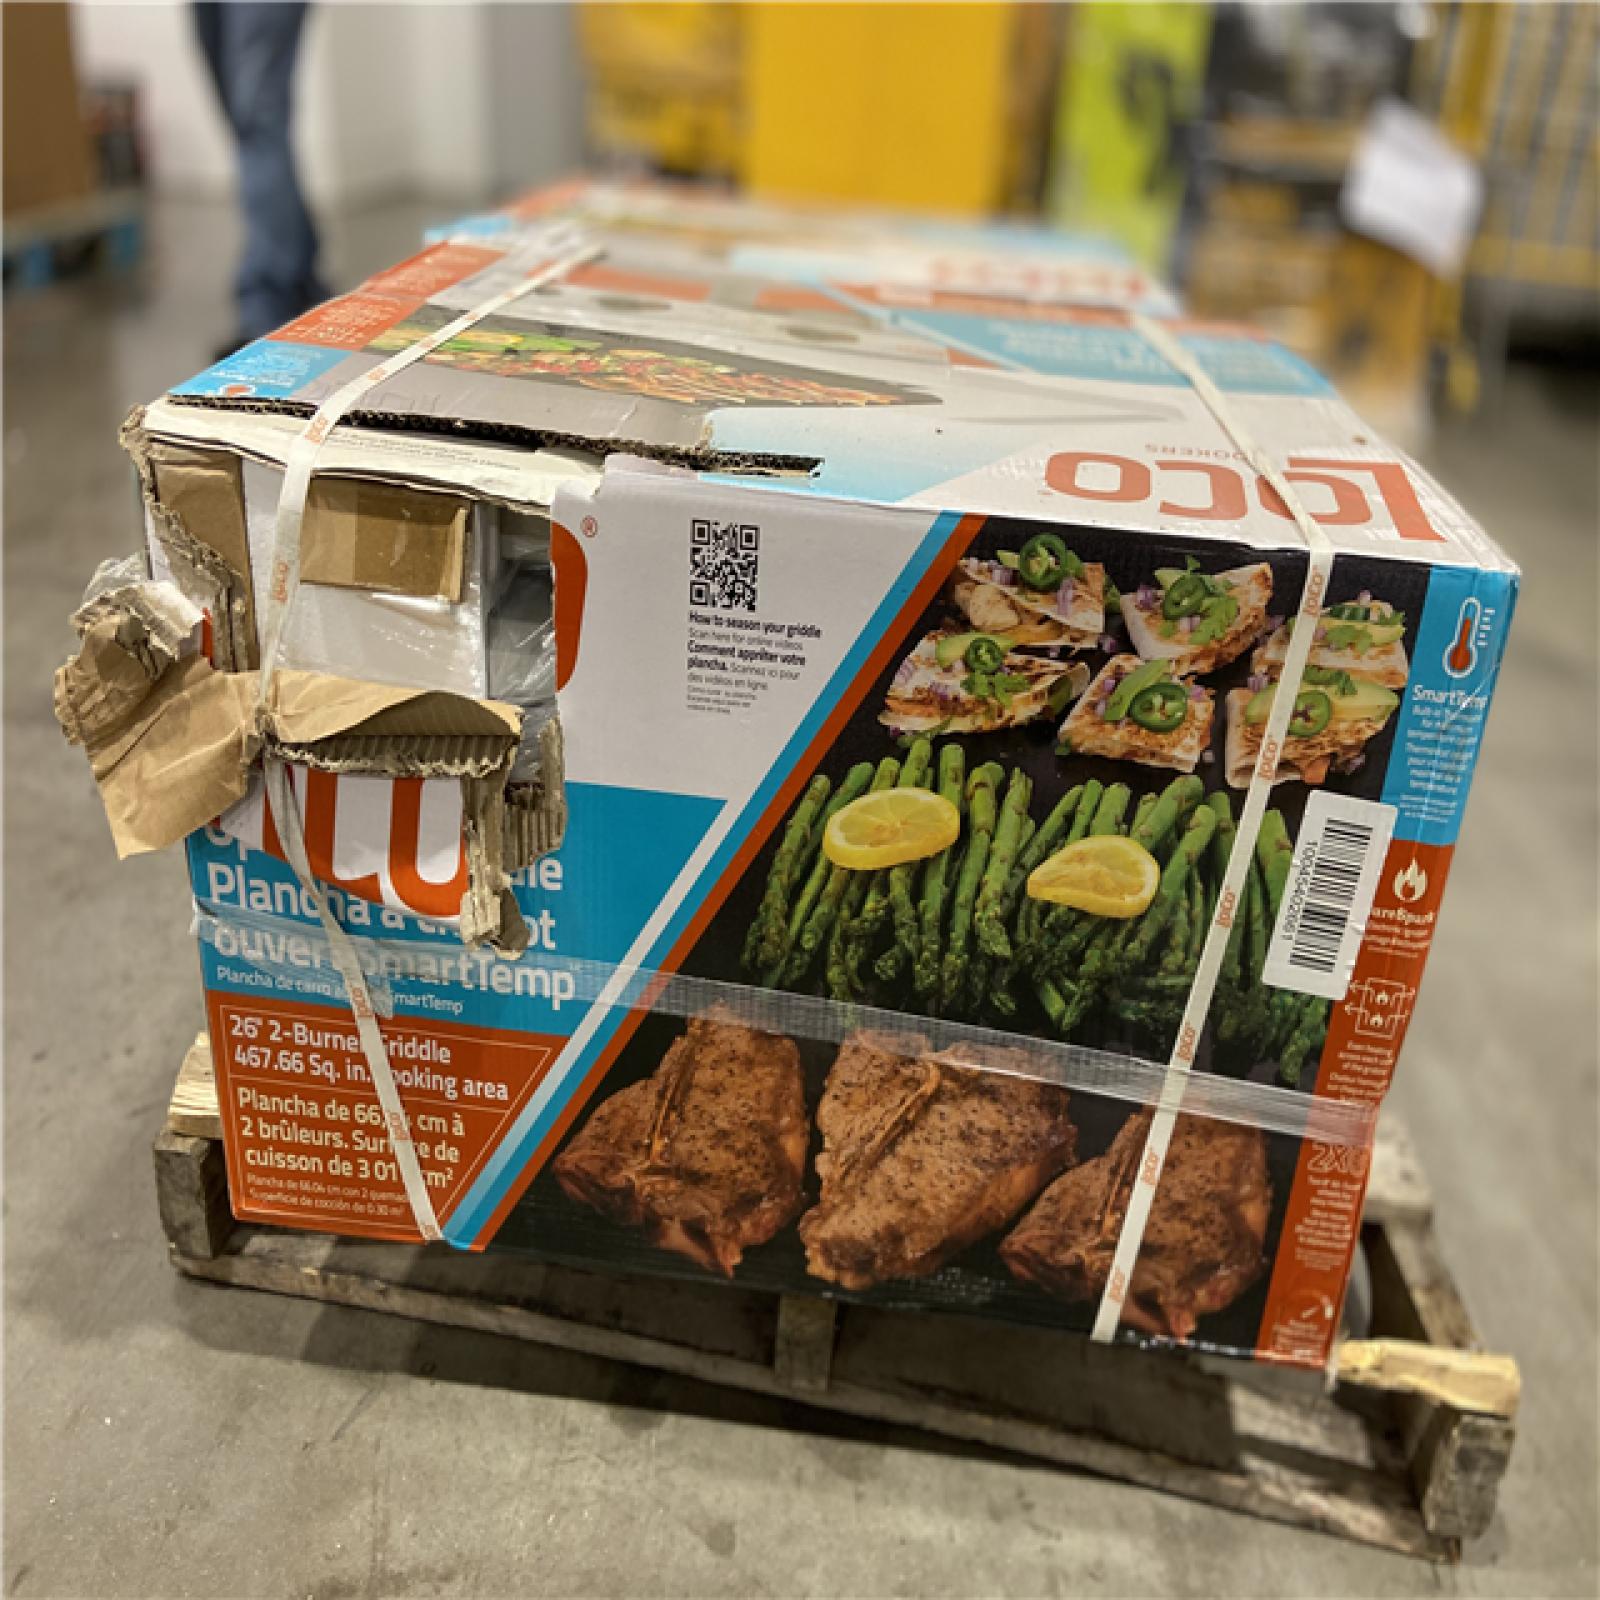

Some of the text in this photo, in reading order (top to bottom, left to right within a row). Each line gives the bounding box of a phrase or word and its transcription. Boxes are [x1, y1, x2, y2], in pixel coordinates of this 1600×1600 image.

[689, 627, 804, 651] Scan here for online videos
[690, 610, 822, 638] How to season your griddle
[688, 639, 736, 656] Comment
[780, 654, 806, 666] votre
[730, 662, 766, 677] Scannez
[779, 669, 801, 681] pour
[688, 672, 703, 683] des
[735, 679, 746, 687] en
[214, 924, 328, 969] ouver
[217, 963, 273, 988] Plancha
[394, 992, 464, 1015] martTemp
[267, 1019, 361, 1053] 2-Burne
[380, 1033, 451, 1064] riddle
[234, 1044, 509, 1101] 467.66 Sq. in. ooking area
[237, 1087, 320, 1118] Plancha
[324, 1097, 351, 1121] de
[417, 1114, 449, 1133] cm
[239, 1114, 254, 1136] 2
[257, 1116, 349, 1148] brûleurs.
[434, 1139, 460, 1164] de
[244, 1145, 454, 1188] cuisson de 3 01 m²
